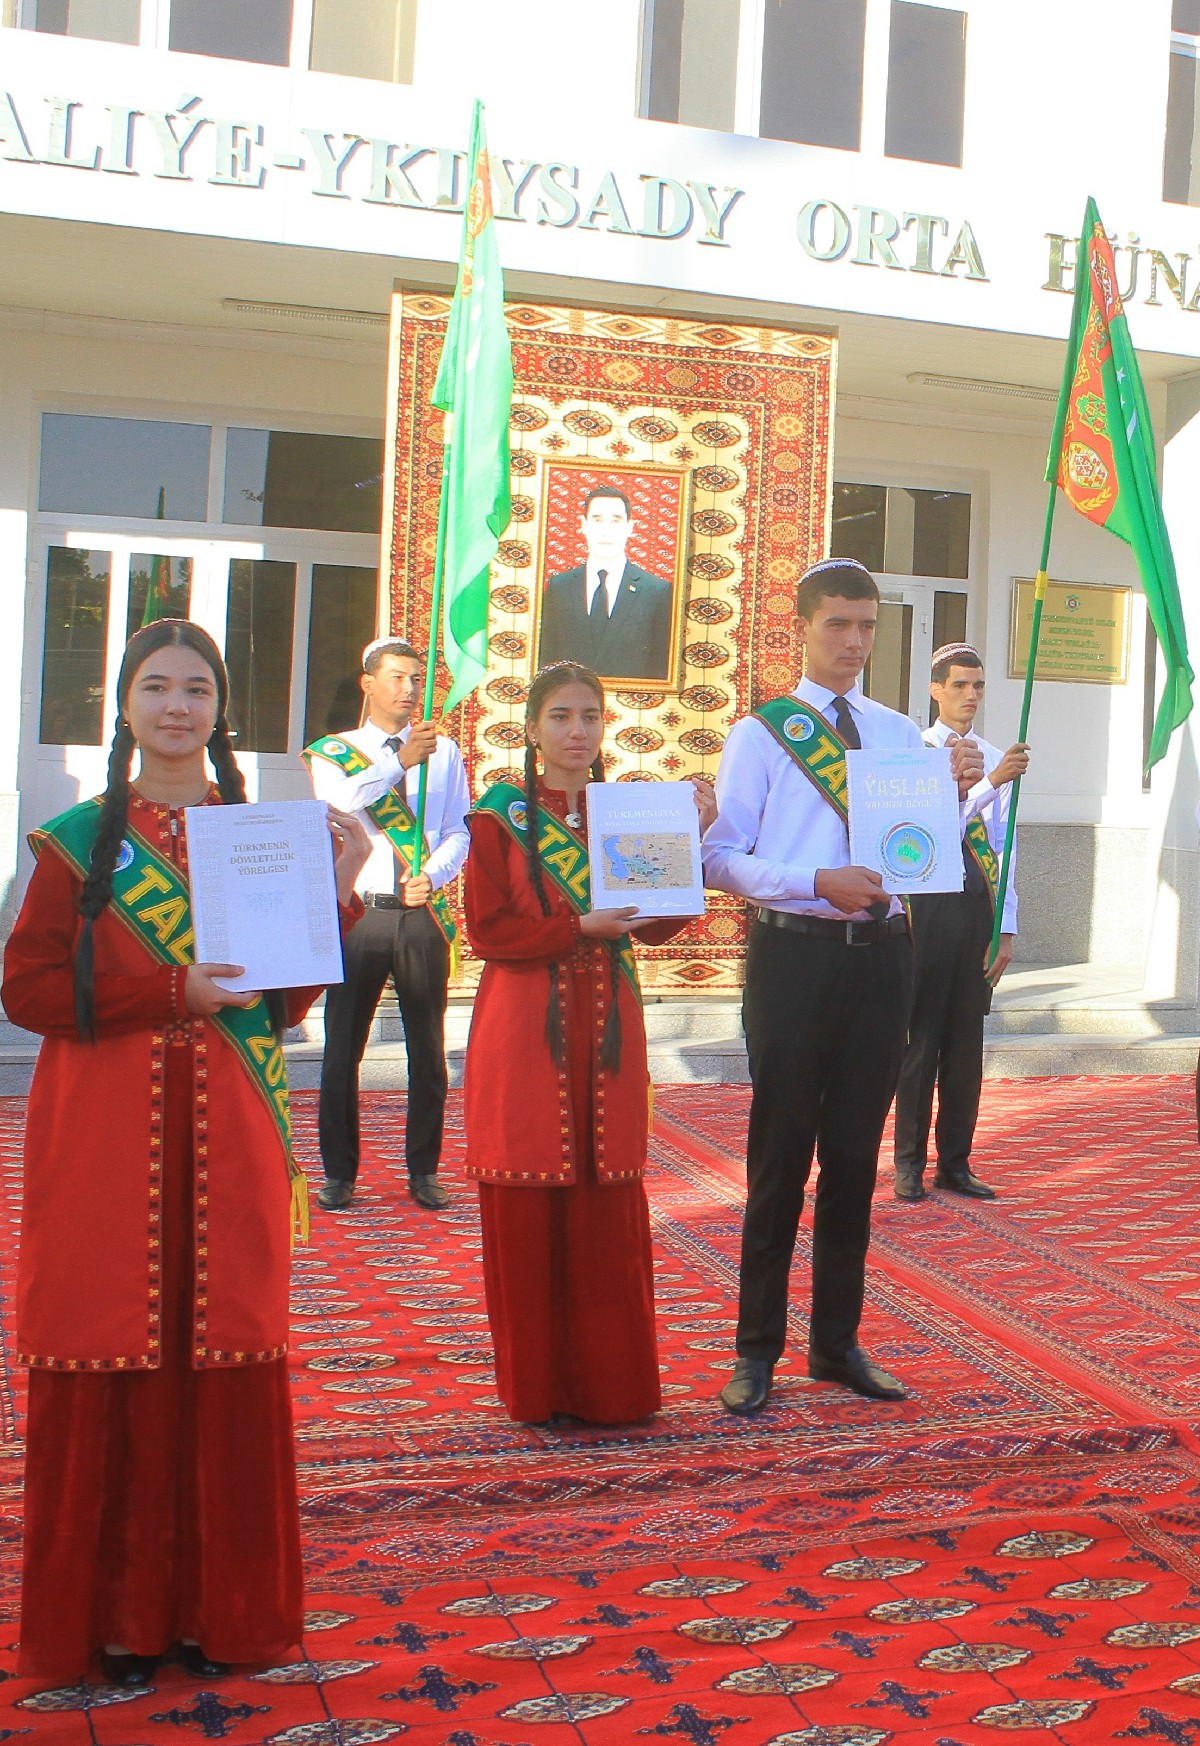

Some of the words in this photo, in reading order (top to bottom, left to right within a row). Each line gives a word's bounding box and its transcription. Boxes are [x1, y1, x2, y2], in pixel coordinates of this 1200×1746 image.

[797, 198, 991, 283] ORTA
[538, 824, 591, 899] TAL
[121, 864, 195, 966] TAL
